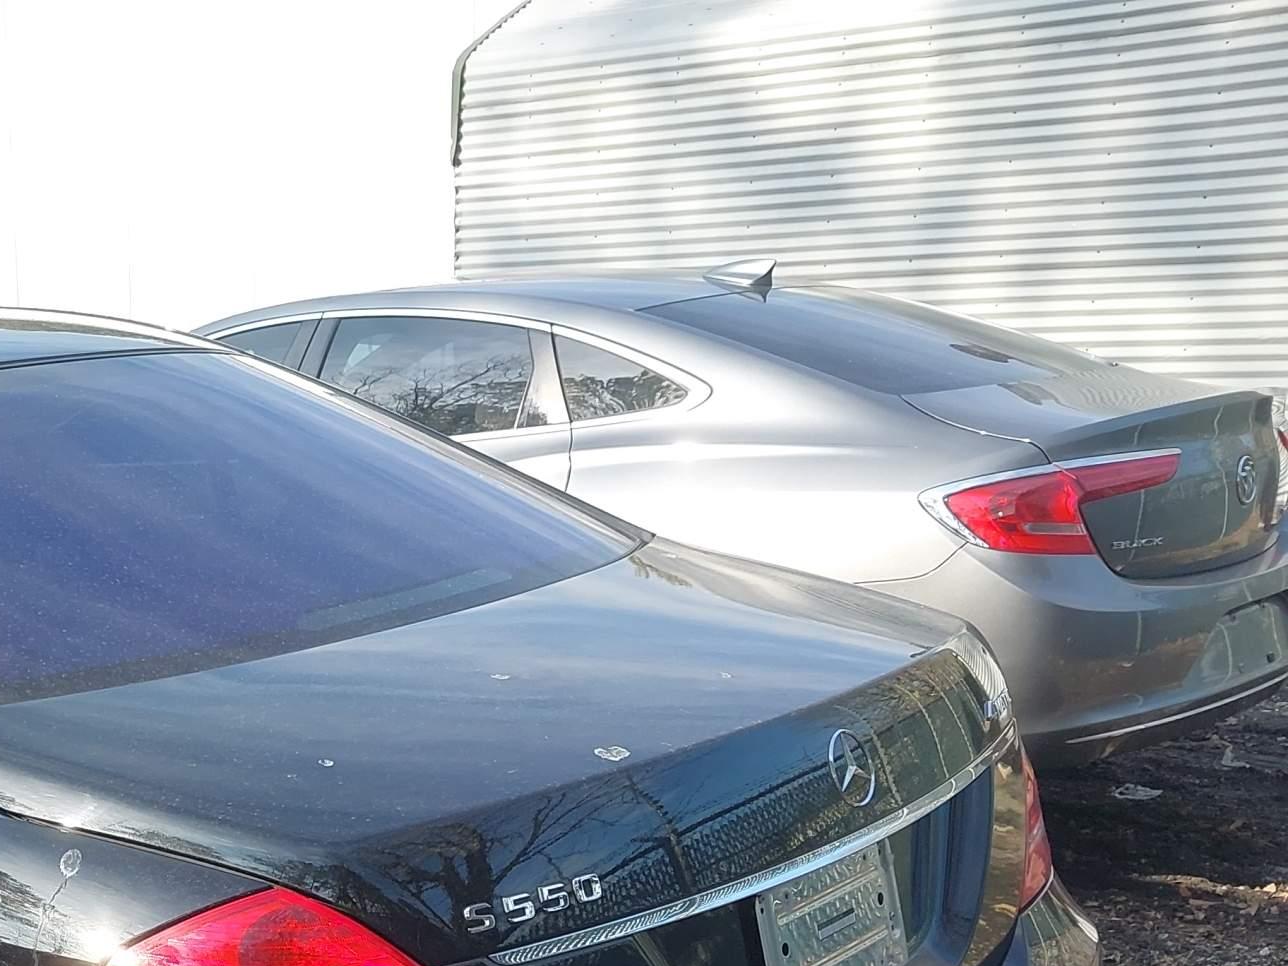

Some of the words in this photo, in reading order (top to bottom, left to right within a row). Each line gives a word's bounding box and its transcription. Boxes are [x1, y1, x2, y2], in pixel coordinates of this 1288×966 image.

[1111, 536, 1165, 550] BUICK
[463, 902, 496, 935] S
[501, 873, 603, 924] 550
